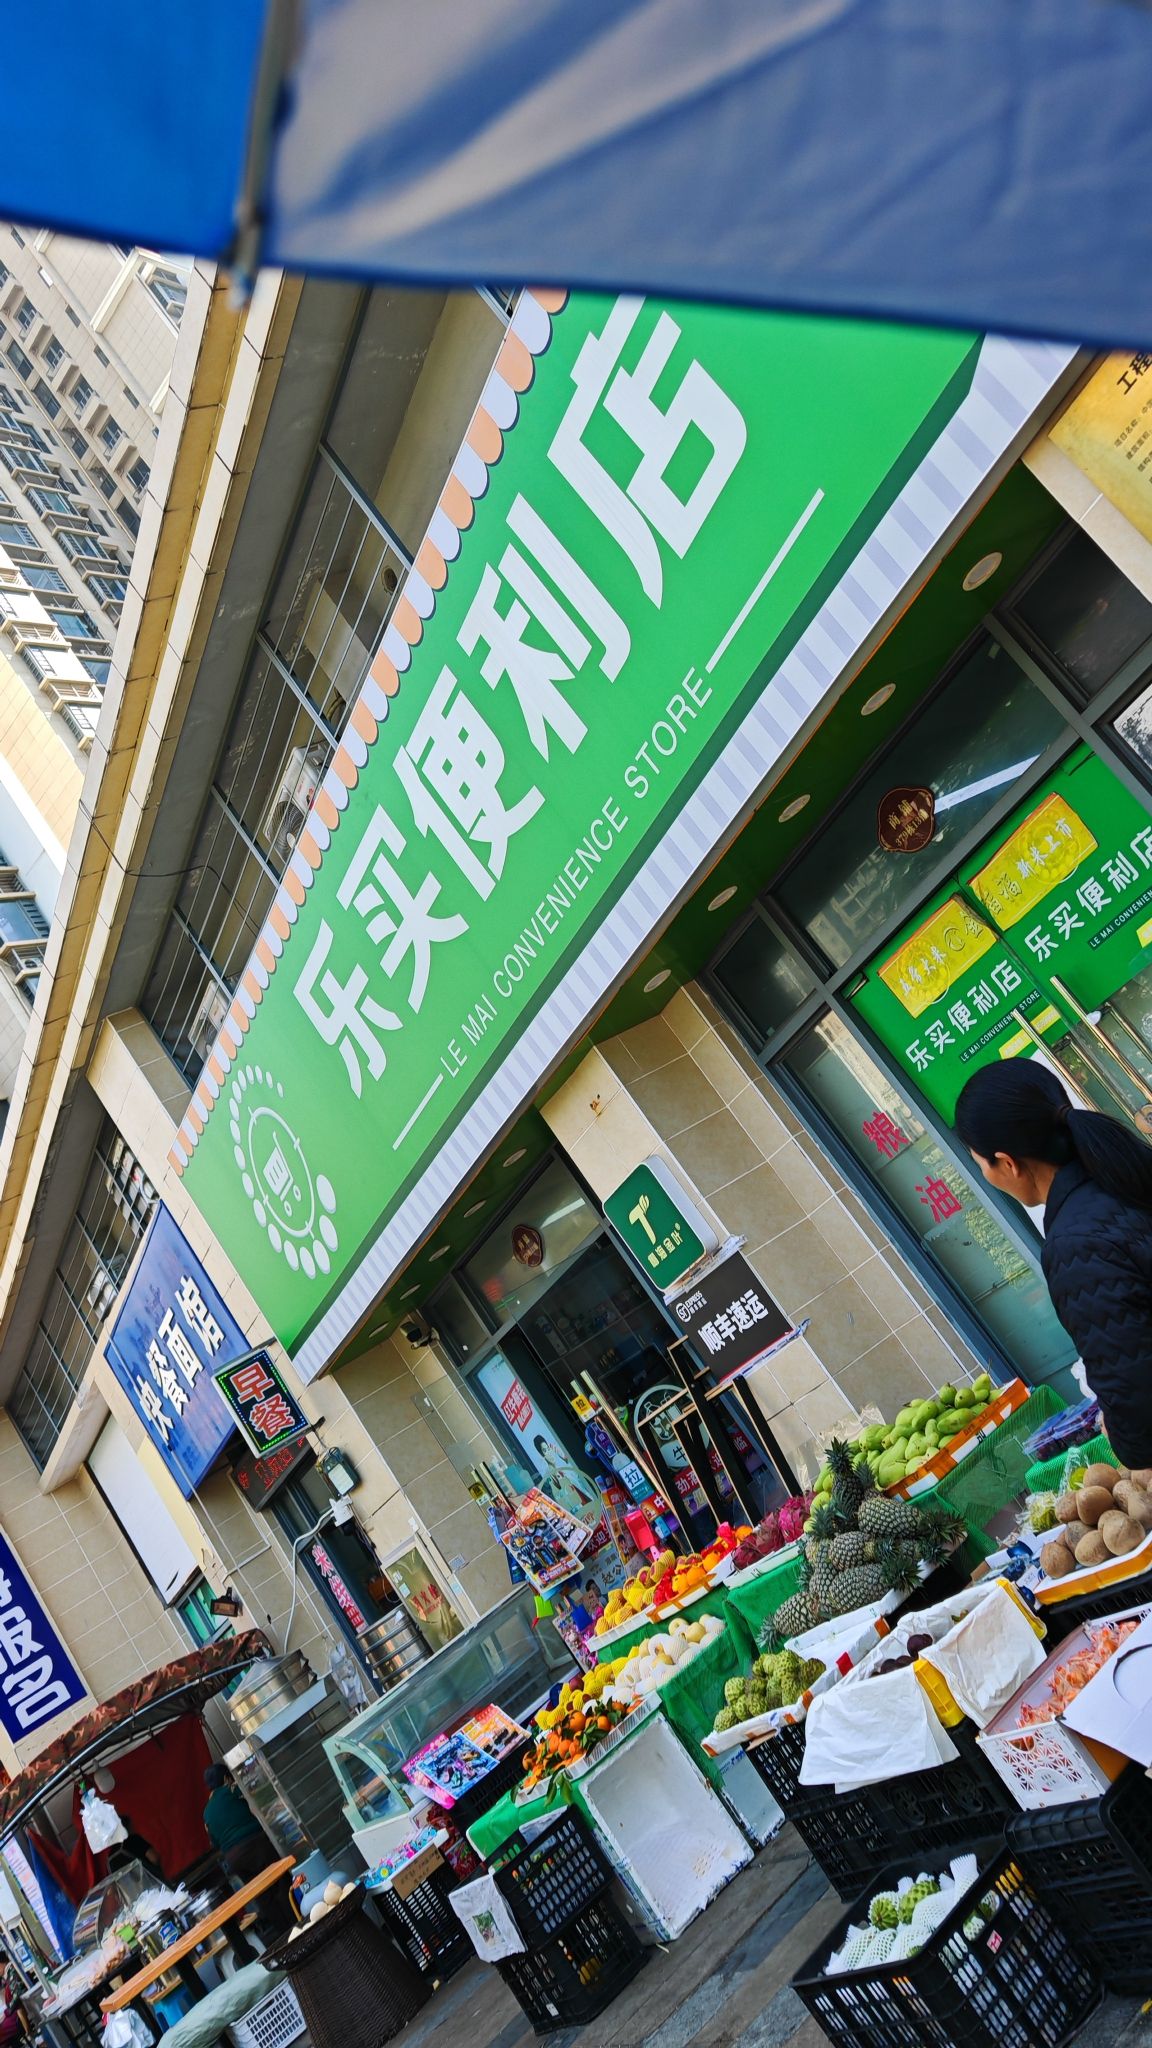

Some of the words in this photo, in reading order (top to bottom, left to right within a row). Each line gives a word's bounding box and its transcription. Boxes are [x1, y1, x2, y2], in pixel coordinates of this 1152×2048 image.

[292, 296, 748, 1100] 乐买便利店
[440, 1039, 467, 1078] LE
[461, 993, 498, 1045] MAI
[492, 796, 629, 998] CONVENIENCE
[623, 666, 713, 799] STORE
[1024, 825, 1152, 963] 乐买便利店
[905, 959, 1022, 1072] 乐买便利店
[980, 1011, 1019, 1045] CONVENIEN
[1019, 990, 1040, 1010] STORE
[685, 1290, 703, 1308] EXPRESS
[697, 1288, 769, 1354] 顺丰速运
[138, 1274, 227, 1443] 快餐面馆
[229, 1361, 297, 1441] 早餐
[624, 1468, 642, 1487] 拉
